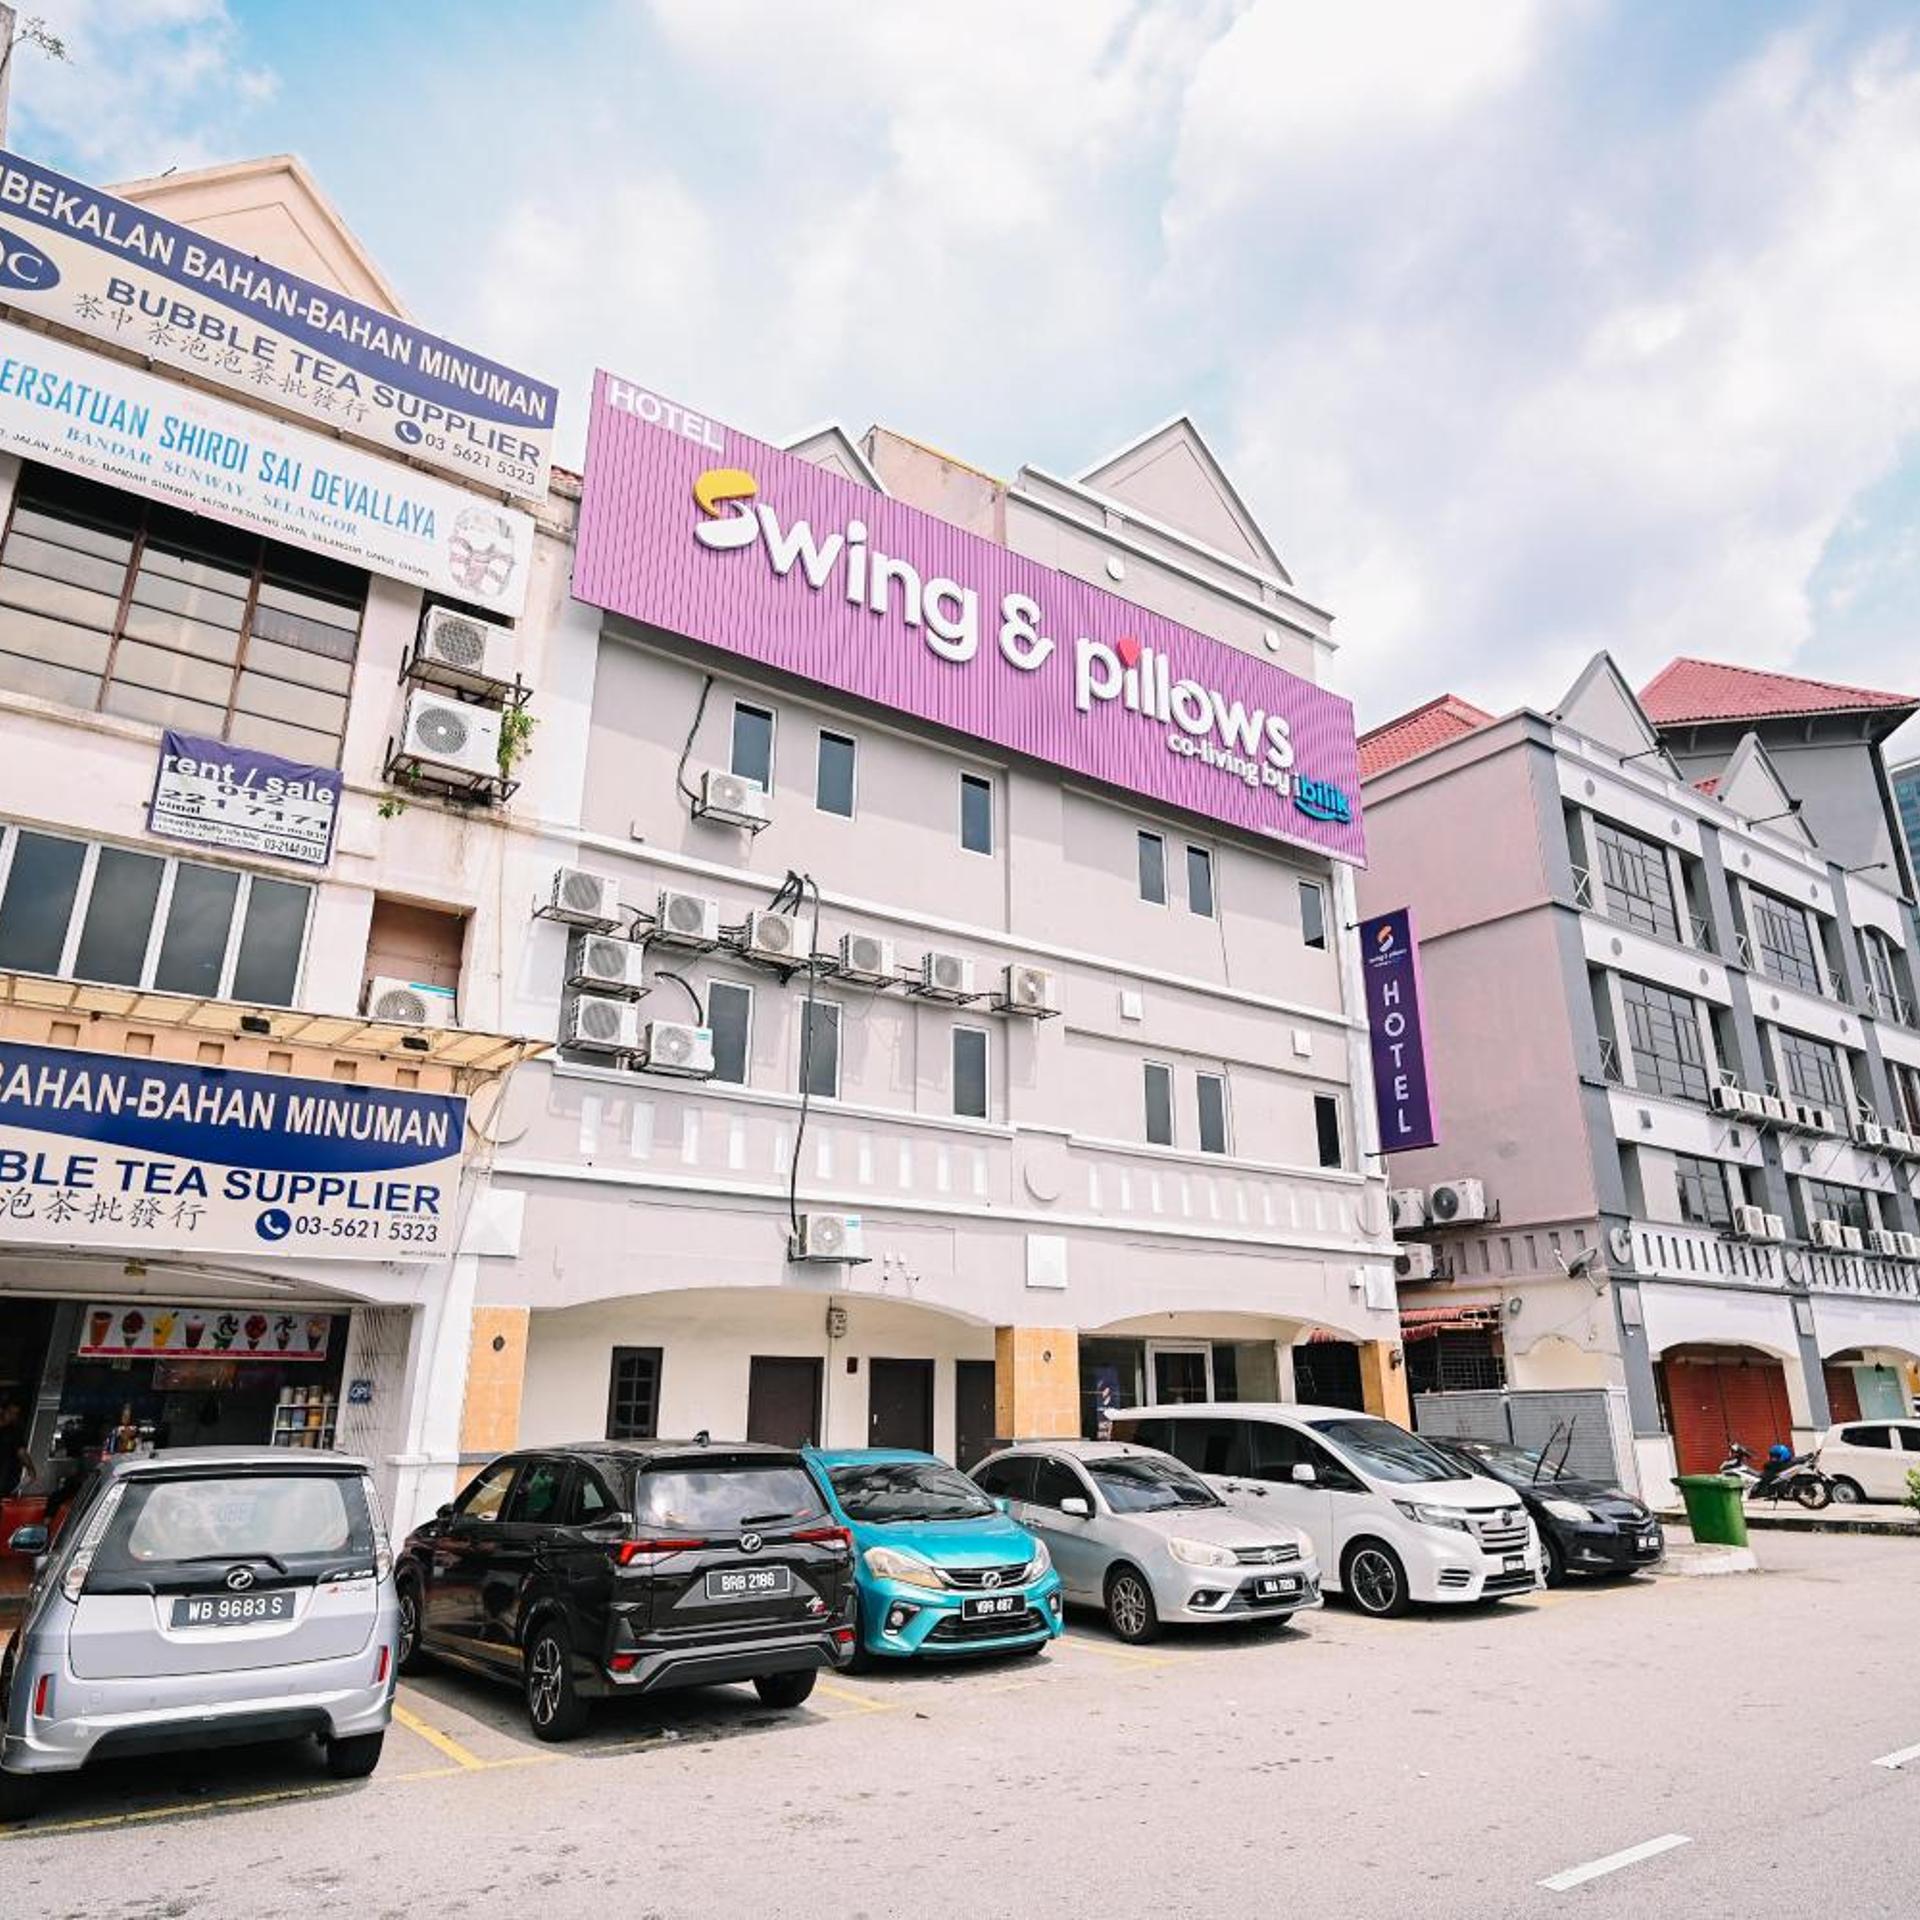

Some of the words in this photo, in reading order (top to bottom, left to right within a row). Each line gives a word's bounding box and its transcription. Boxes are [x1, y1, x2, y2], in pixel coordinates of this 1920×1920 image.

[0, 240, 43, 284] C
[0, 165, 175, 266] BEKALAN
[182, 245, 412, 366] BAHAN-BAHAN
[418, 345, 547, 422] MINUMAN
[106, 277, 278, 364] BUBBLE
[290, 349, 362, 398] TEA
[372, 384, 541, 468] SUPPLIER
[609, 379, 725, 454] HOTEL
[65, 426, 153, 467] BANDAR
[263, 493, 359, 537] SELANGOR
[159, 414, 249, 475] SHIRDI
[258, 450, 302, 493] SAI
[310, 468, 436, 540] DEVALLAYA
[425, 434, 446, 451] 03
[452, 444, 491, 468] 5621
[496, 461, 536, 486] 5323
[692, 467, 979, 663] Swing
[998, 592, 1055, 671] &
[1074, 634, 1295, 769] pillows
[162, 753, 235, 785] rent
[264, 776, 335, 805] sale
[1167, 733, 1260, 788] co-living
[1260, 760, 1291, 798] by
[1382, 979, 1412, 1134] HOTEL
[0, 1061, 276, 1131] AHAN-BAHAN
[285, 1095, 449, 1149] MINUMAN
[0, 1186, 208, 1232] 泡茶批發行
[115, 1159, 209, 1199] TEA
[223, 1169, 441, 1215] SUPPLIER
[295, 1216, 381, 1239] 03-5621
[388, 1221, 438, 1243] 5323
[188, 1601, 214, 1621] WB
[217, 1598, 266, 1618] 9683
[270, 1598, 284, 1616] S
